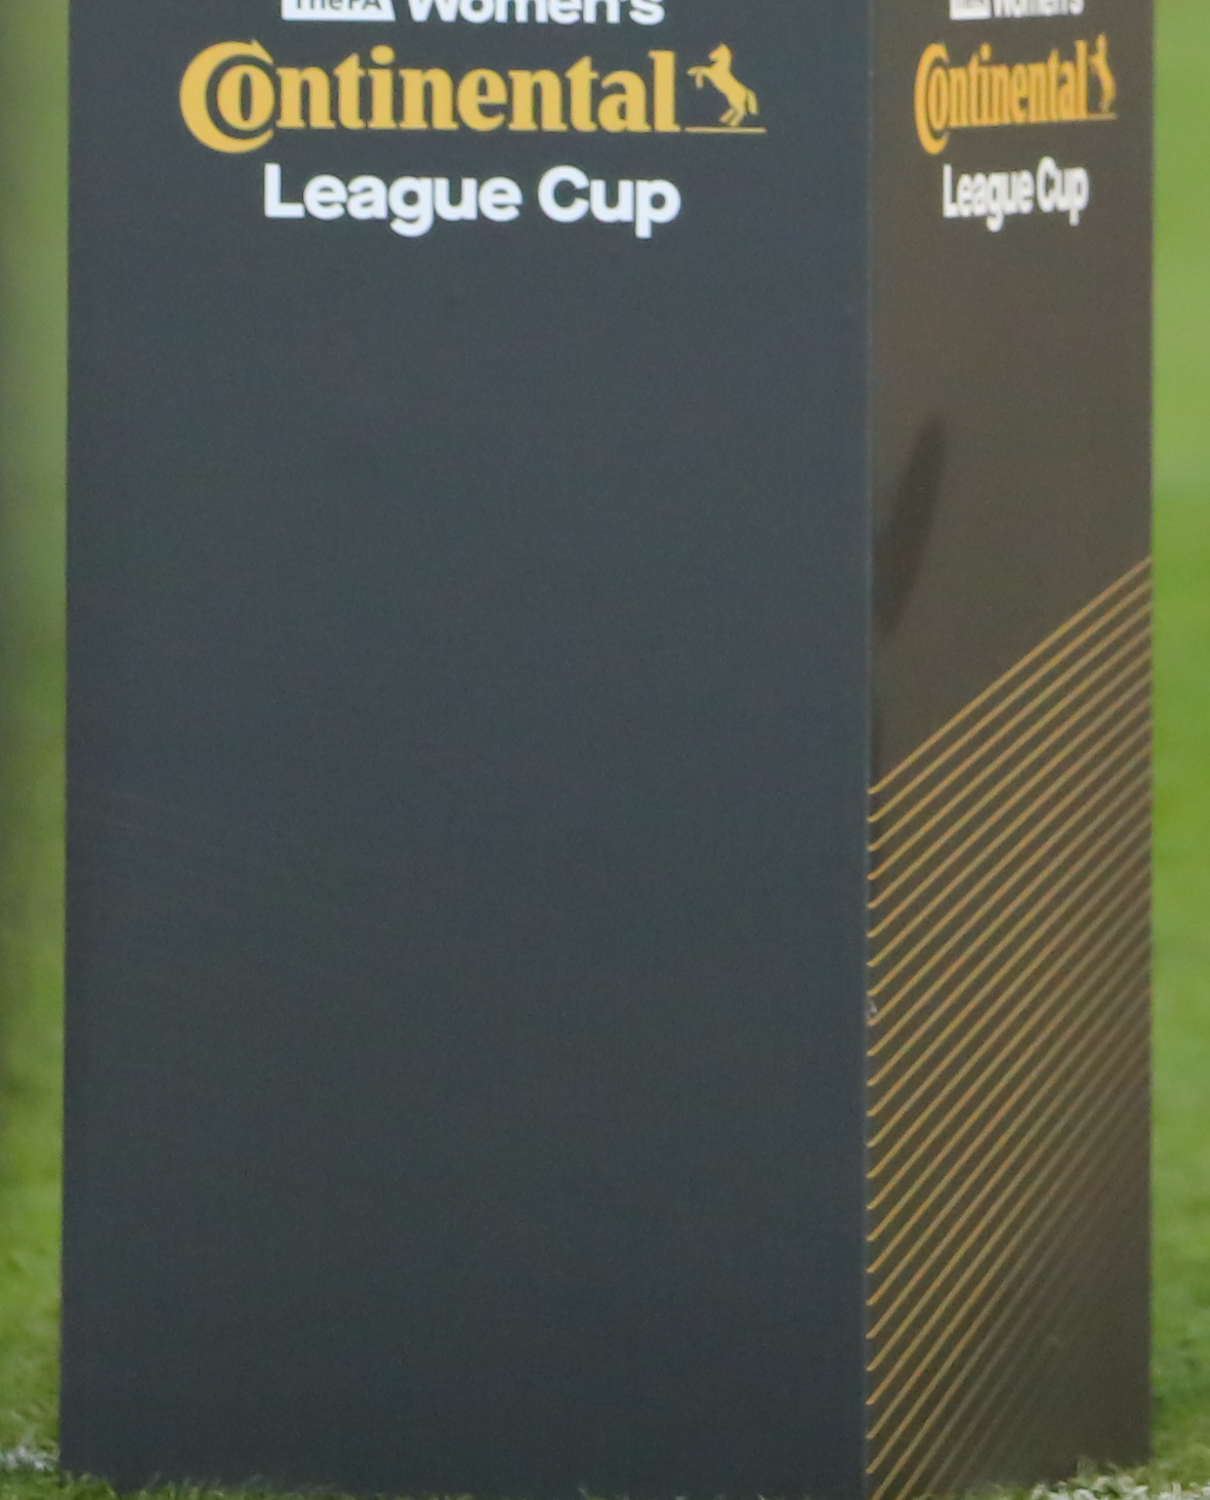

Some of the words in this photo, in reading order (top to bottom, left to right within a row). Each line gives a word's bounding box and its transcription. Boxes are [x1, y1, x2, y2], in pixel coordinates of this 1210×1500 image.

[179, 39, 682, 154] Continental
[914, 39, 1088, 155] Continental
[263, 162, 523, 237] League
[537, 164, 682, 239] Cup
[943, 163, 1035, 233] League
[1036, 156, 1090, 227] Cup
